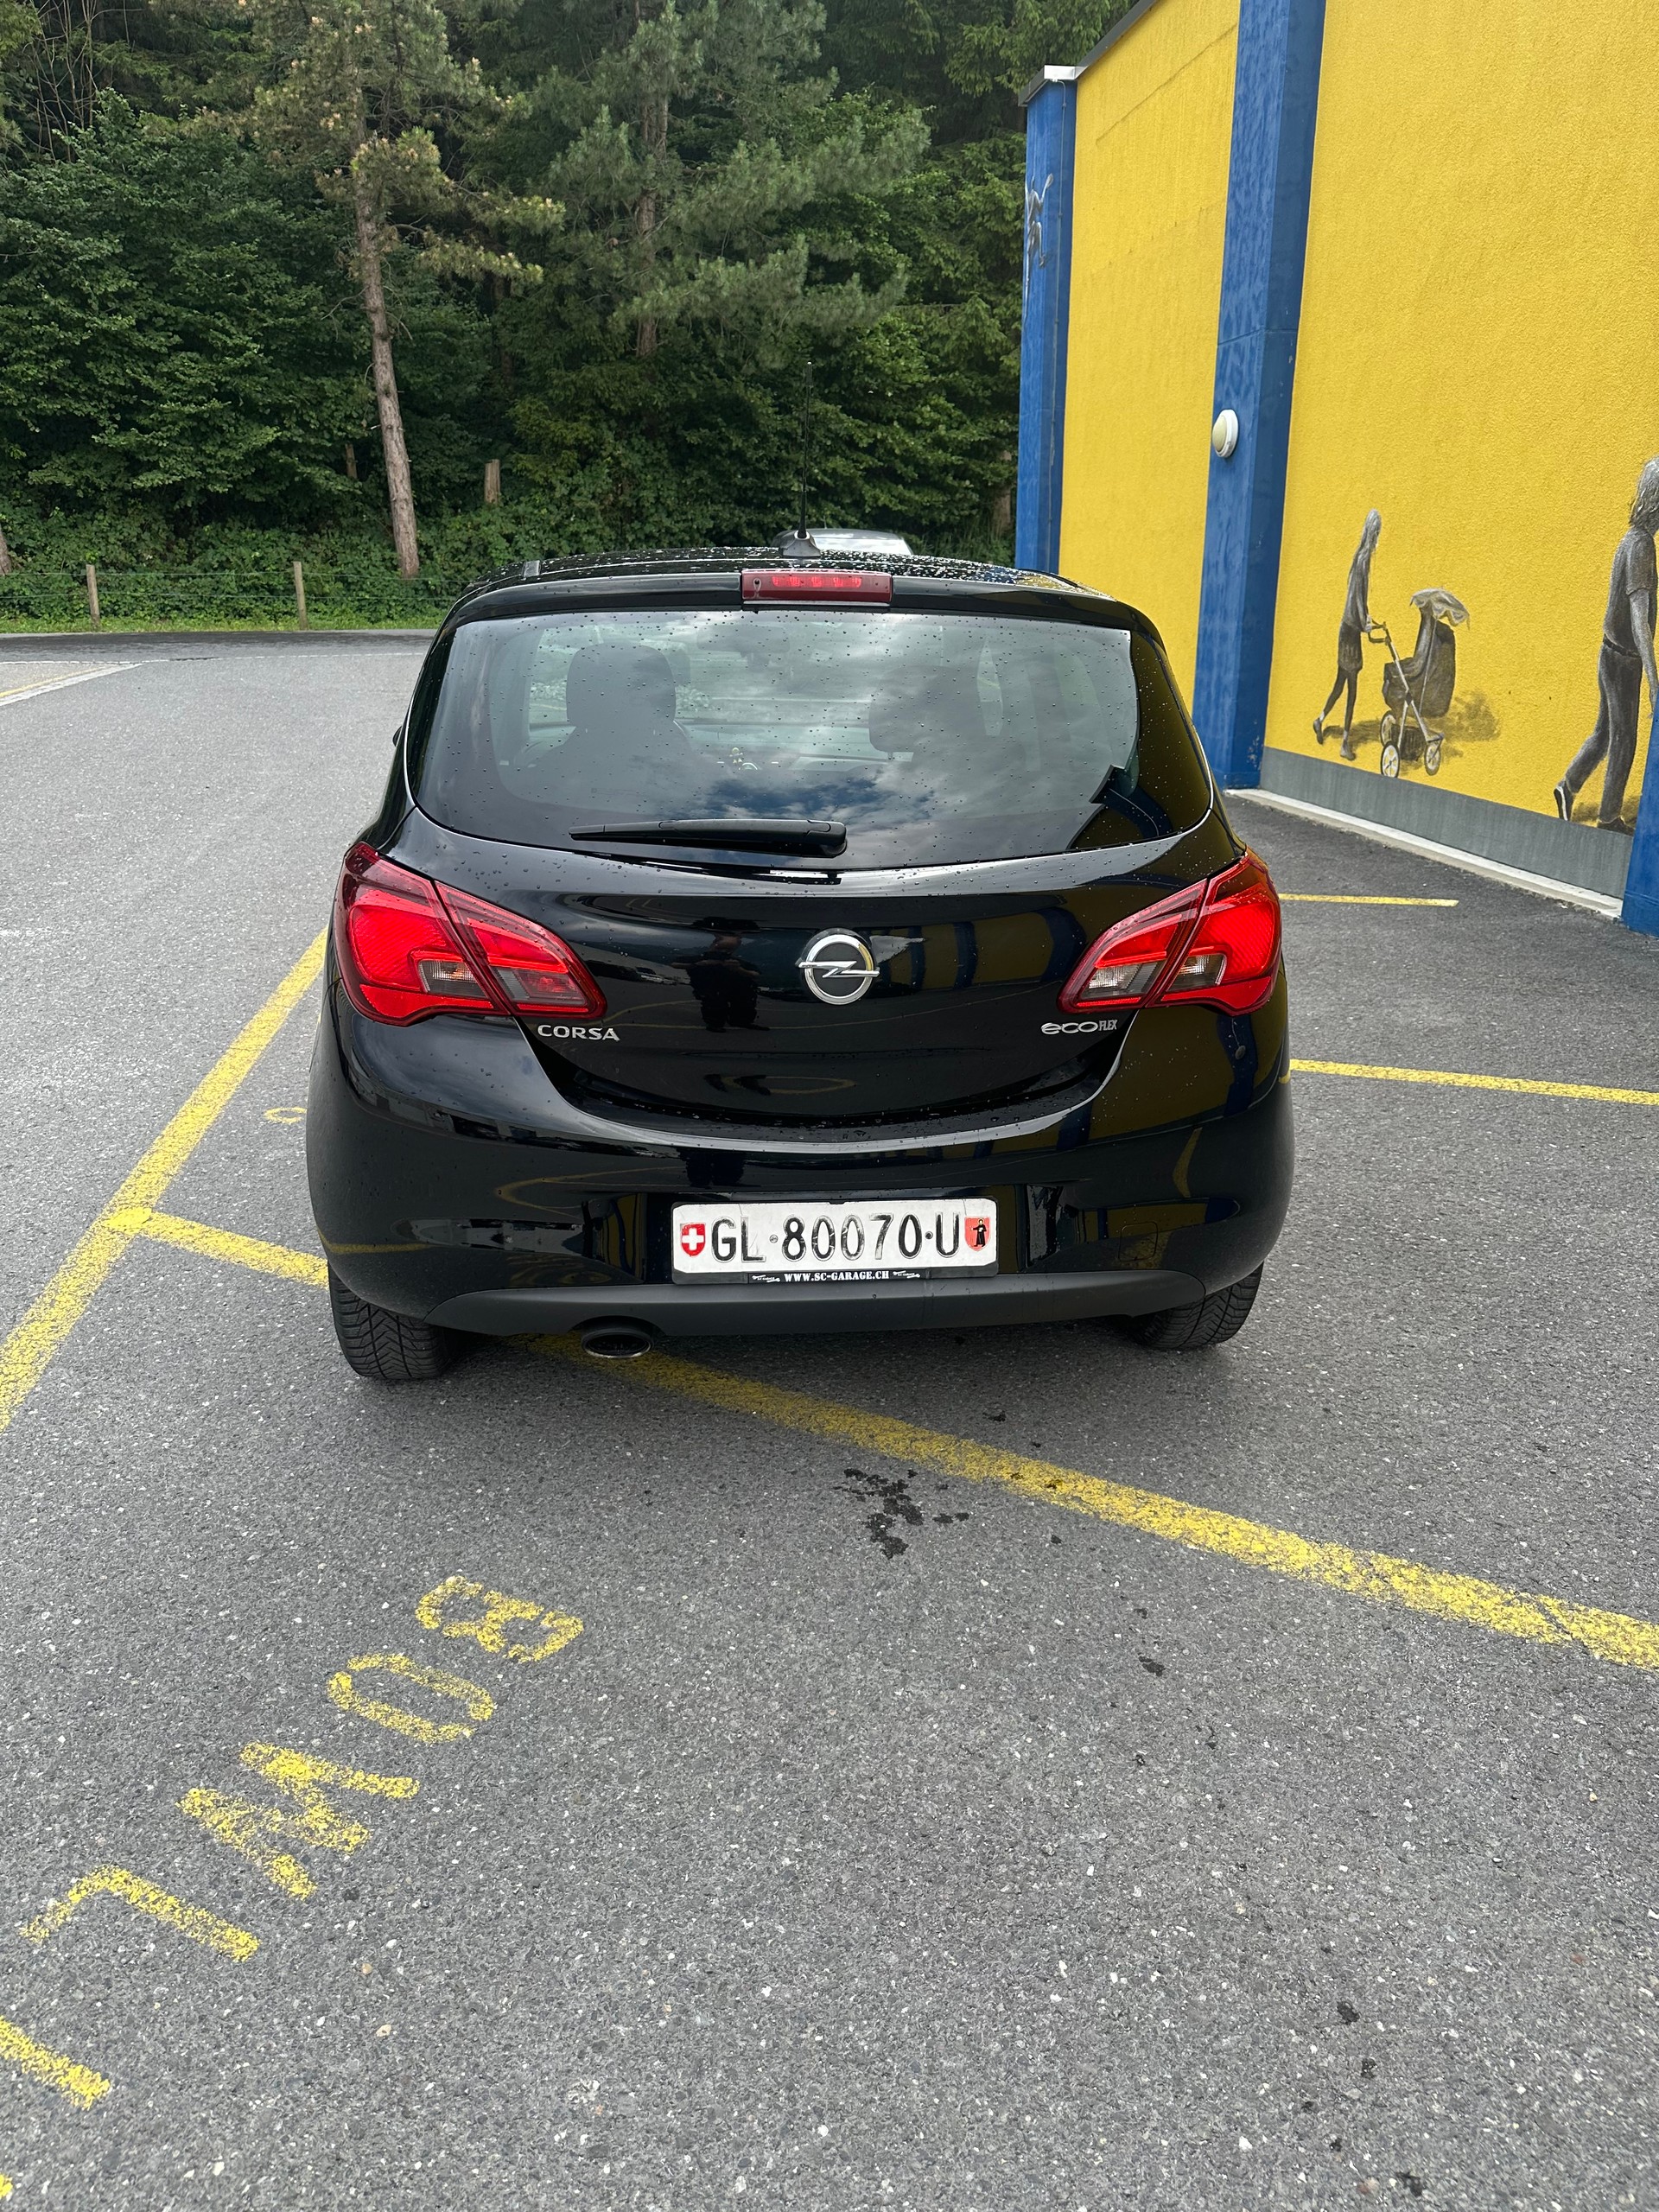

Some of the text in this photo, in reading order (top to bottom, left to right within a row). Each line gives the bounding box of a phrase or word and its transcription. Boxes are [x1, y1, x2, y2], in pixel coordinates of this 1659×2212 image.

[537, 1025, 620, 1042] CORSA
[711, 1211, 960, 1262] GL 80070 U
[784, 1270, 890, 1282] WWW.SC-GARAGE.CH
[0, 1575, 584, 2198] BOWLI
